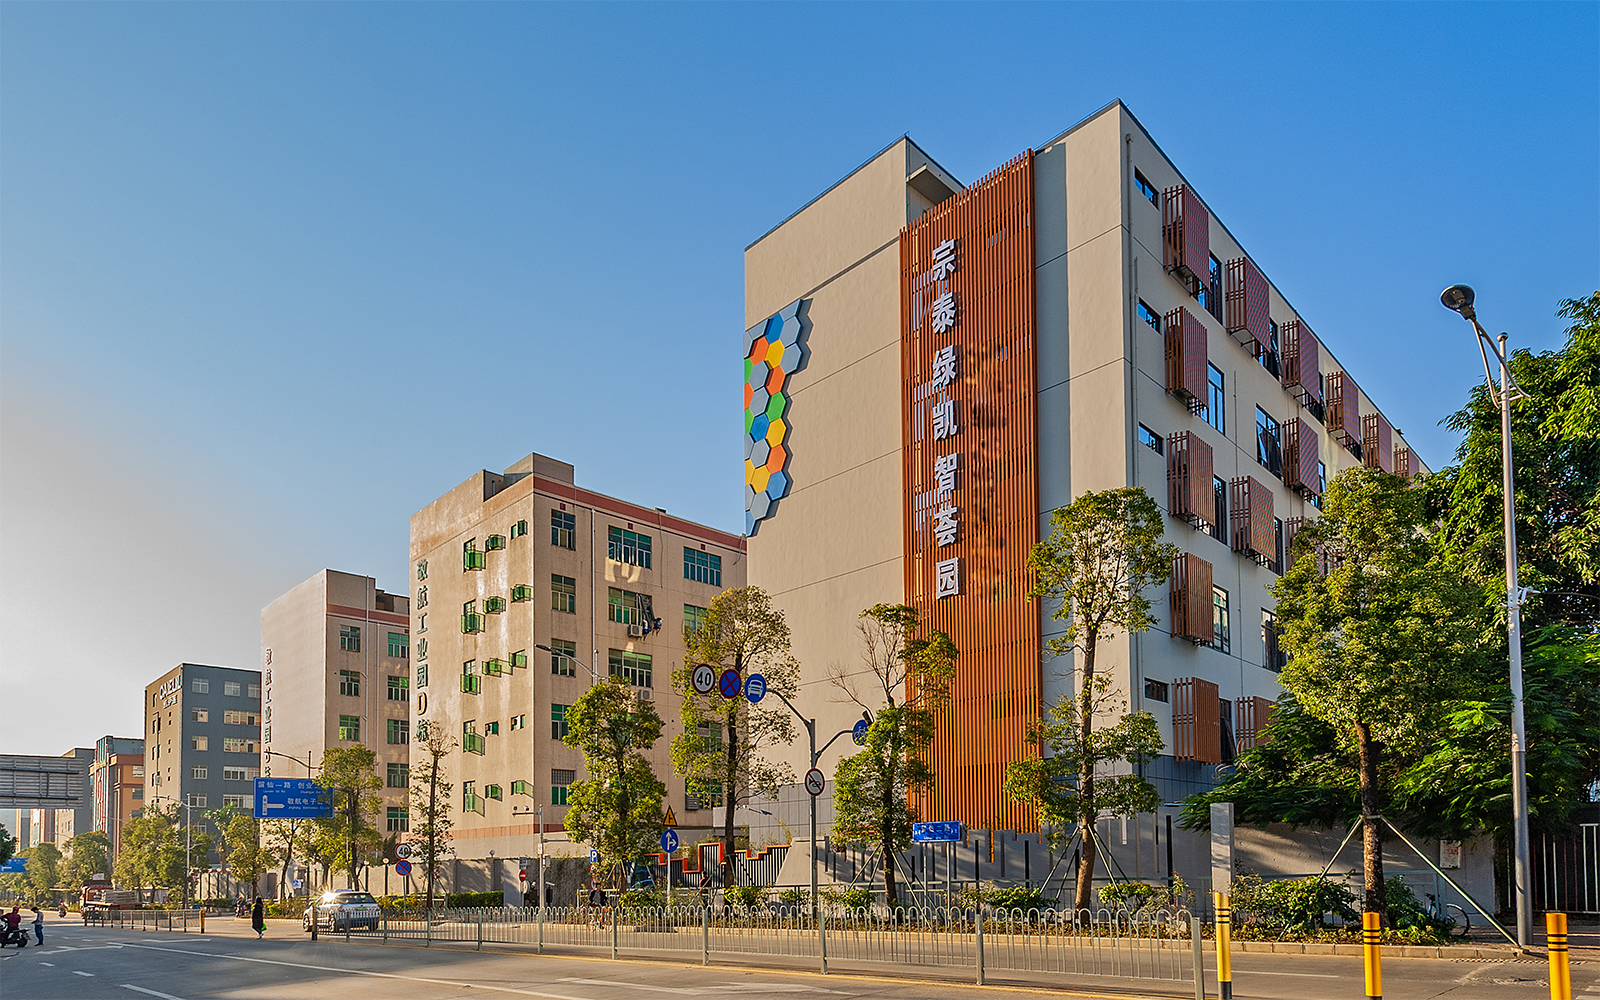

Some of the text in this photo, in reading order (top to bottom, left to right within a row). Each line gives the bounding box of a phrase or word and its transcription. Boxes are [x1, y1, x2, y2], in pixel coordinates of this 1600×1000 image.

[932, 238, 959, 599] 宗泰绿凯智荟园
[696, 671, 712, 687] 40
